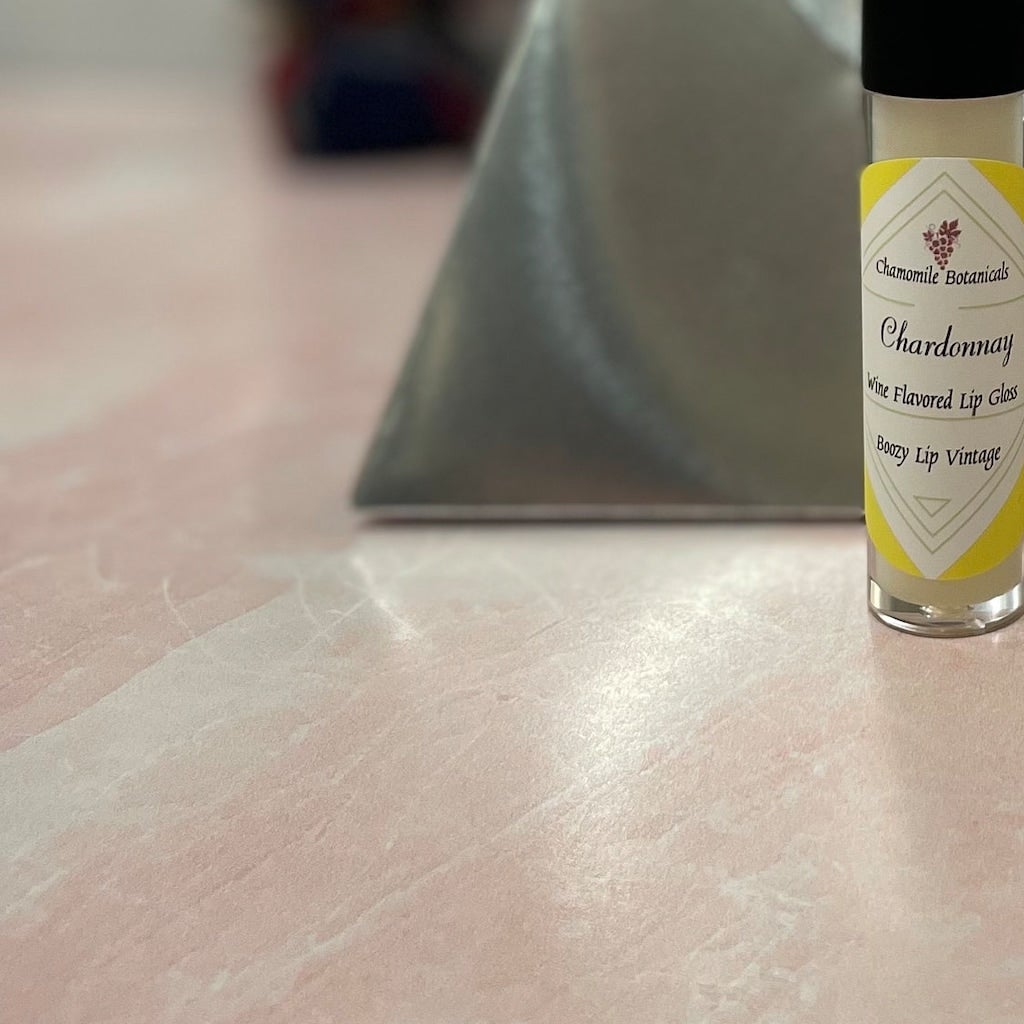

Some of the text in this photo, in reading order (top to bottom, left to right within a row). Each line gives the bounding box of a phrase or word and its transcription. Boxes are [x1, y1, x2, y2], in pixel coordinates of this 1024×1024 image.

[876, 257, 1009, 285] Chamomile Botanicals
[880, 316, 1014, 367] Chardonnay
[867, 372, 1018, 416] Wine Flavored Lip Gloss
[876, 434, 1001, 472] Boozy Lip Vintage
